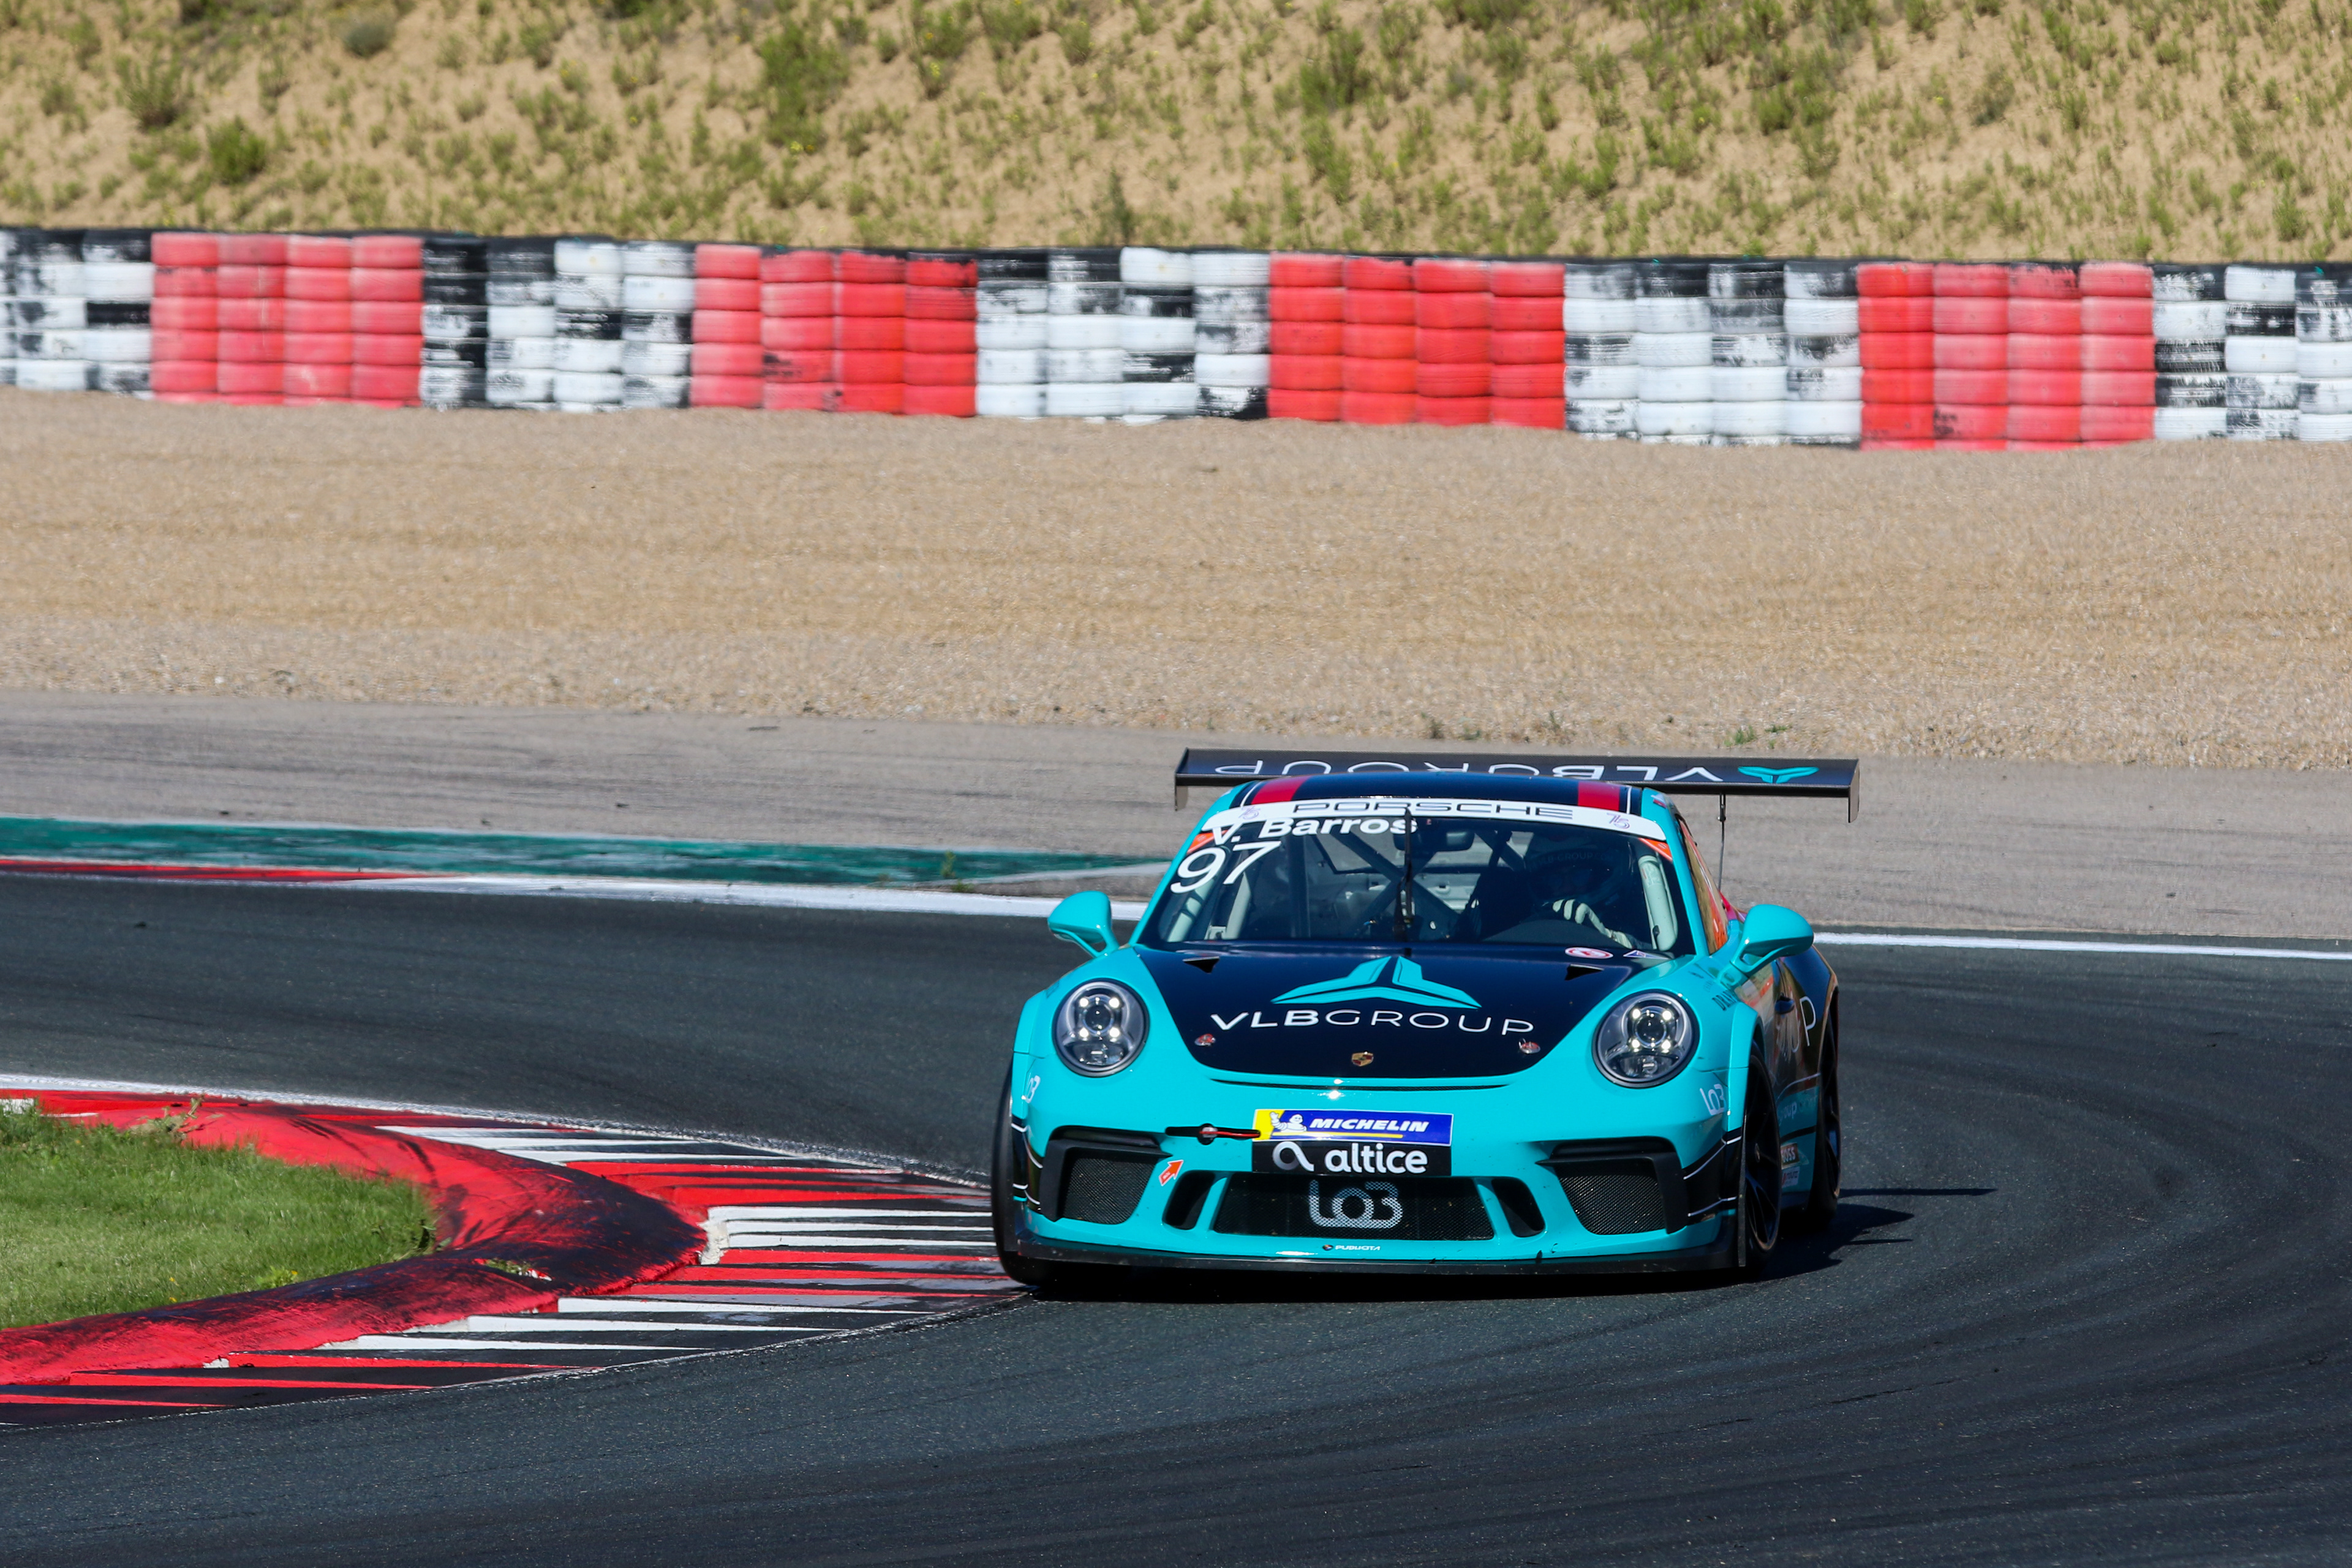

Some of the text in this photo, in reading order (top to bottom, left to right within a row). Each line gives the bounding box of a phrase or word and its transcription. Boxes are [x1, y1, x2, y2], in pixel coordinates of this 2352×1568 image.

[1292, 802, 1574, 820] PORSCHE
[1257, 817, 1418, 839] Barros
[1170, 840, 1281, 894] 97
[1210, 1009, 1534, 1036] VLBGROUP
[1310, 1118, 1430, 1133] MICHELIN
[1324, 1142, 1428, 1174] altice
